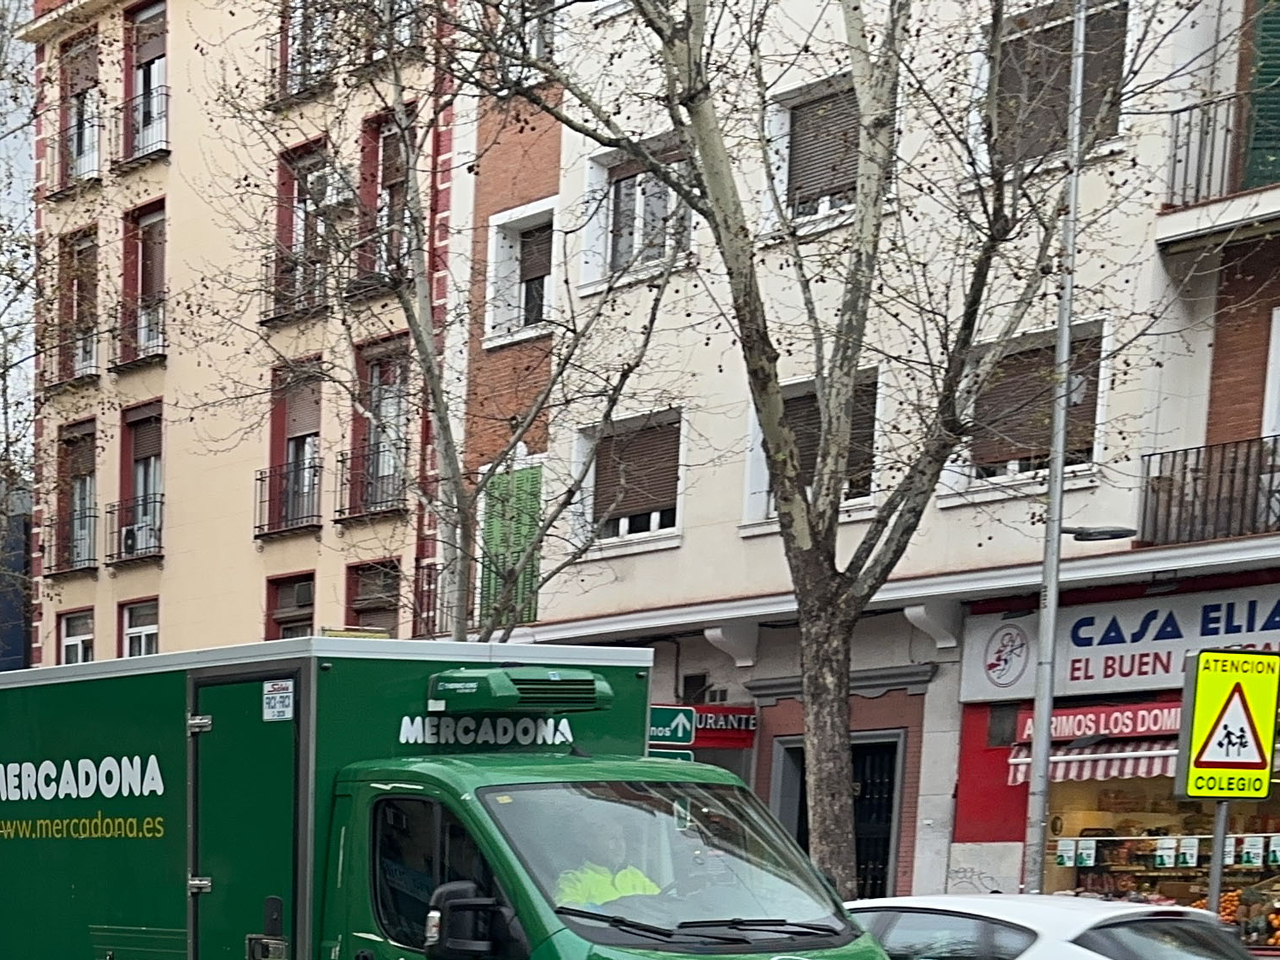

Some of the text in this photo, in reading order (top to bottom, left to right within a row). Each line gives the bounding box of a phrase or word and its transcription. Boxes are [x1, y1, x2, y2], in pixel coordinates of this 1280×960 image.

[1071, 609, 1183, 647] CASA
[1070, 651, 1171, 681] EL BUEN
[1203, 659, 1276, 674] ATENCION
[399, 716, 573, 745] MERCADONA
[1023, 714, 1096, 739] ARIMOS
[1100, 711, 1133, 734] LOS
[1195, 775, 1263, 792] COLEGIO
